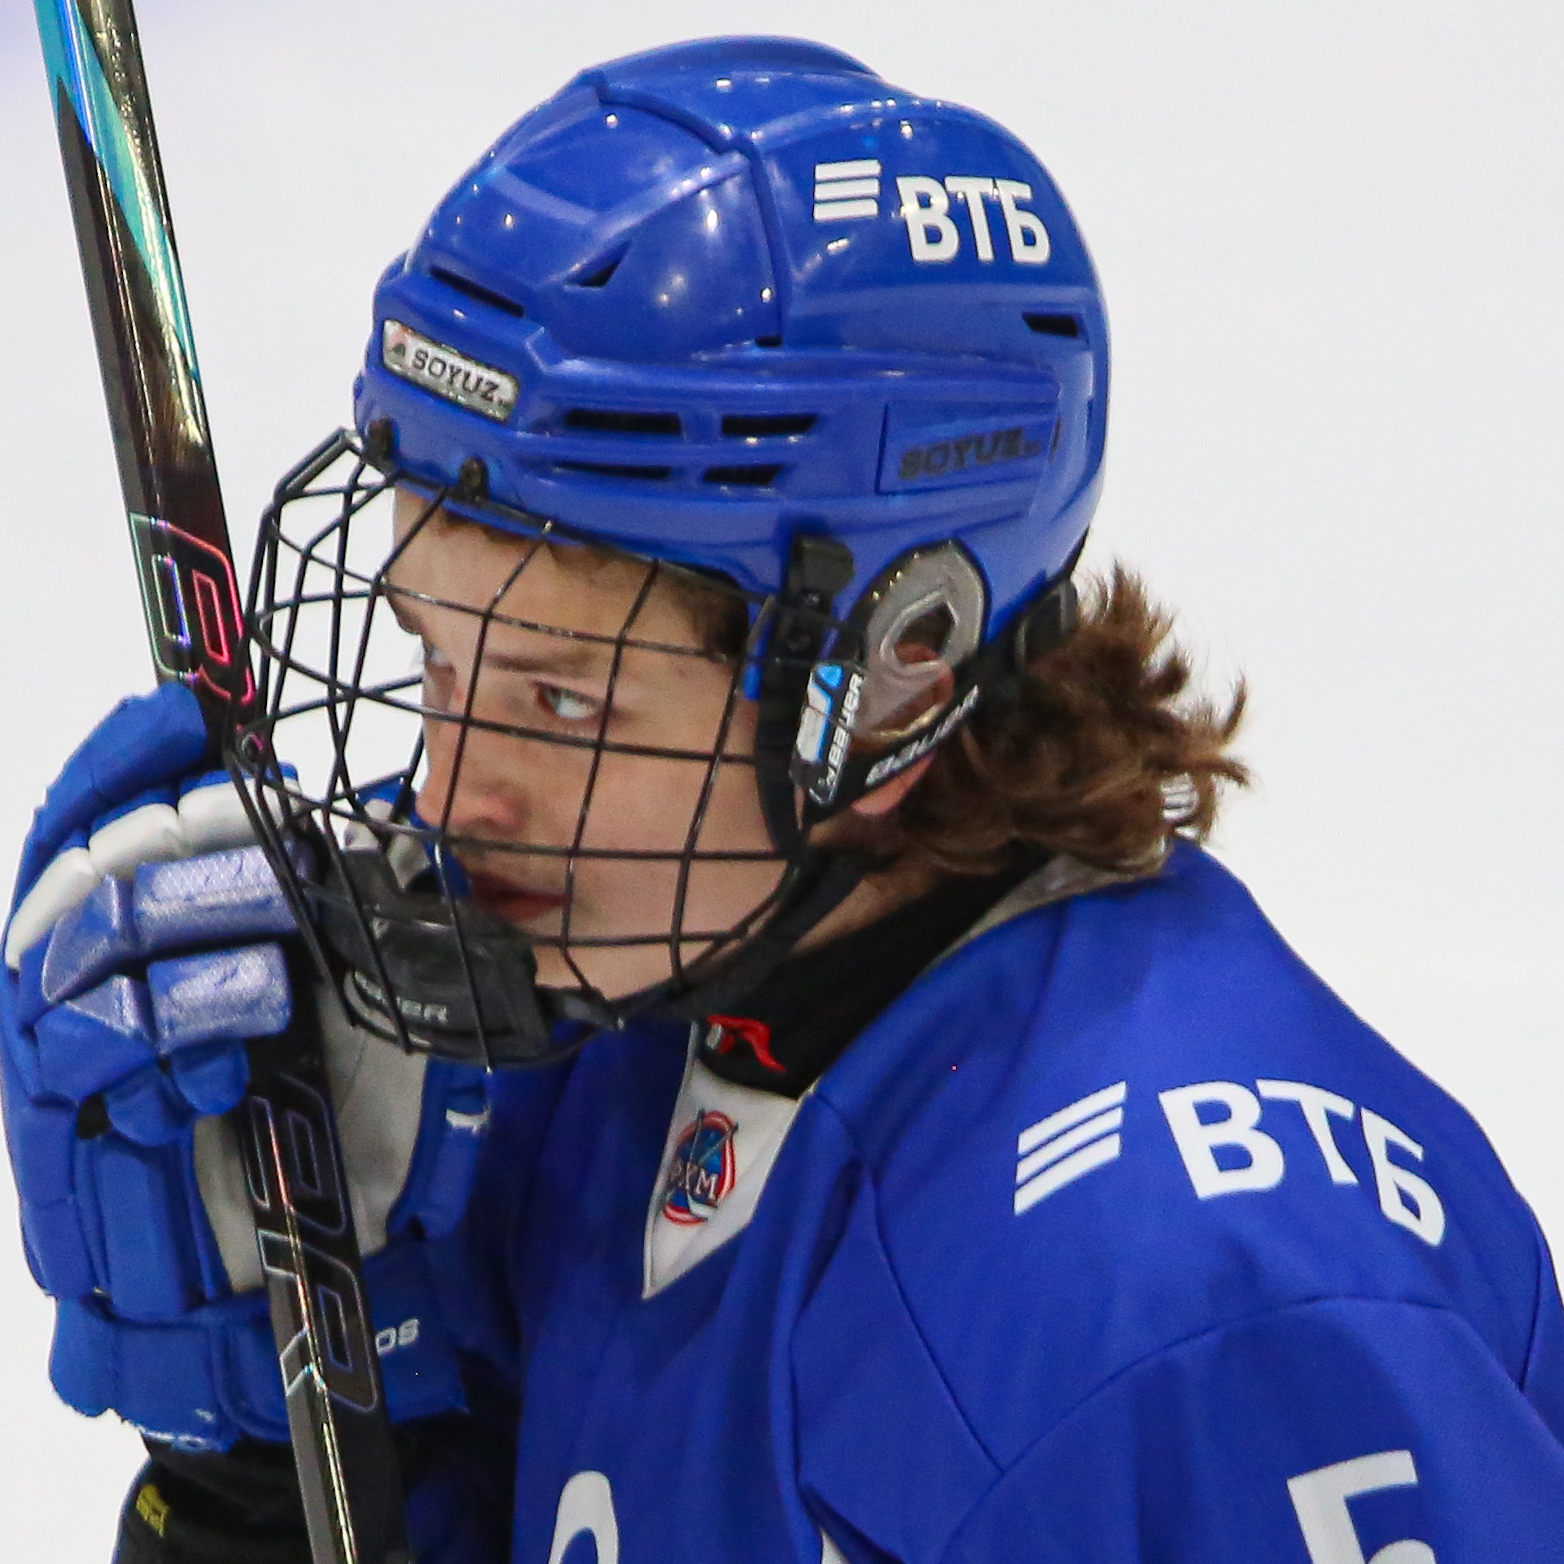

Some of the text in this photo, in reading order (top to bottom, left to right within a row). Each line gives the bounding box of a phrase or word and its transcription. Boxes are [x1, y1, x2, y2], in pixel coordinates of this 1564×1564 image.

[897, 174, 1053, 265] ВТБ
[411, 347, 500, 402] SOYUZ
[1158, 1079, 1446, 1247] ВТБ
